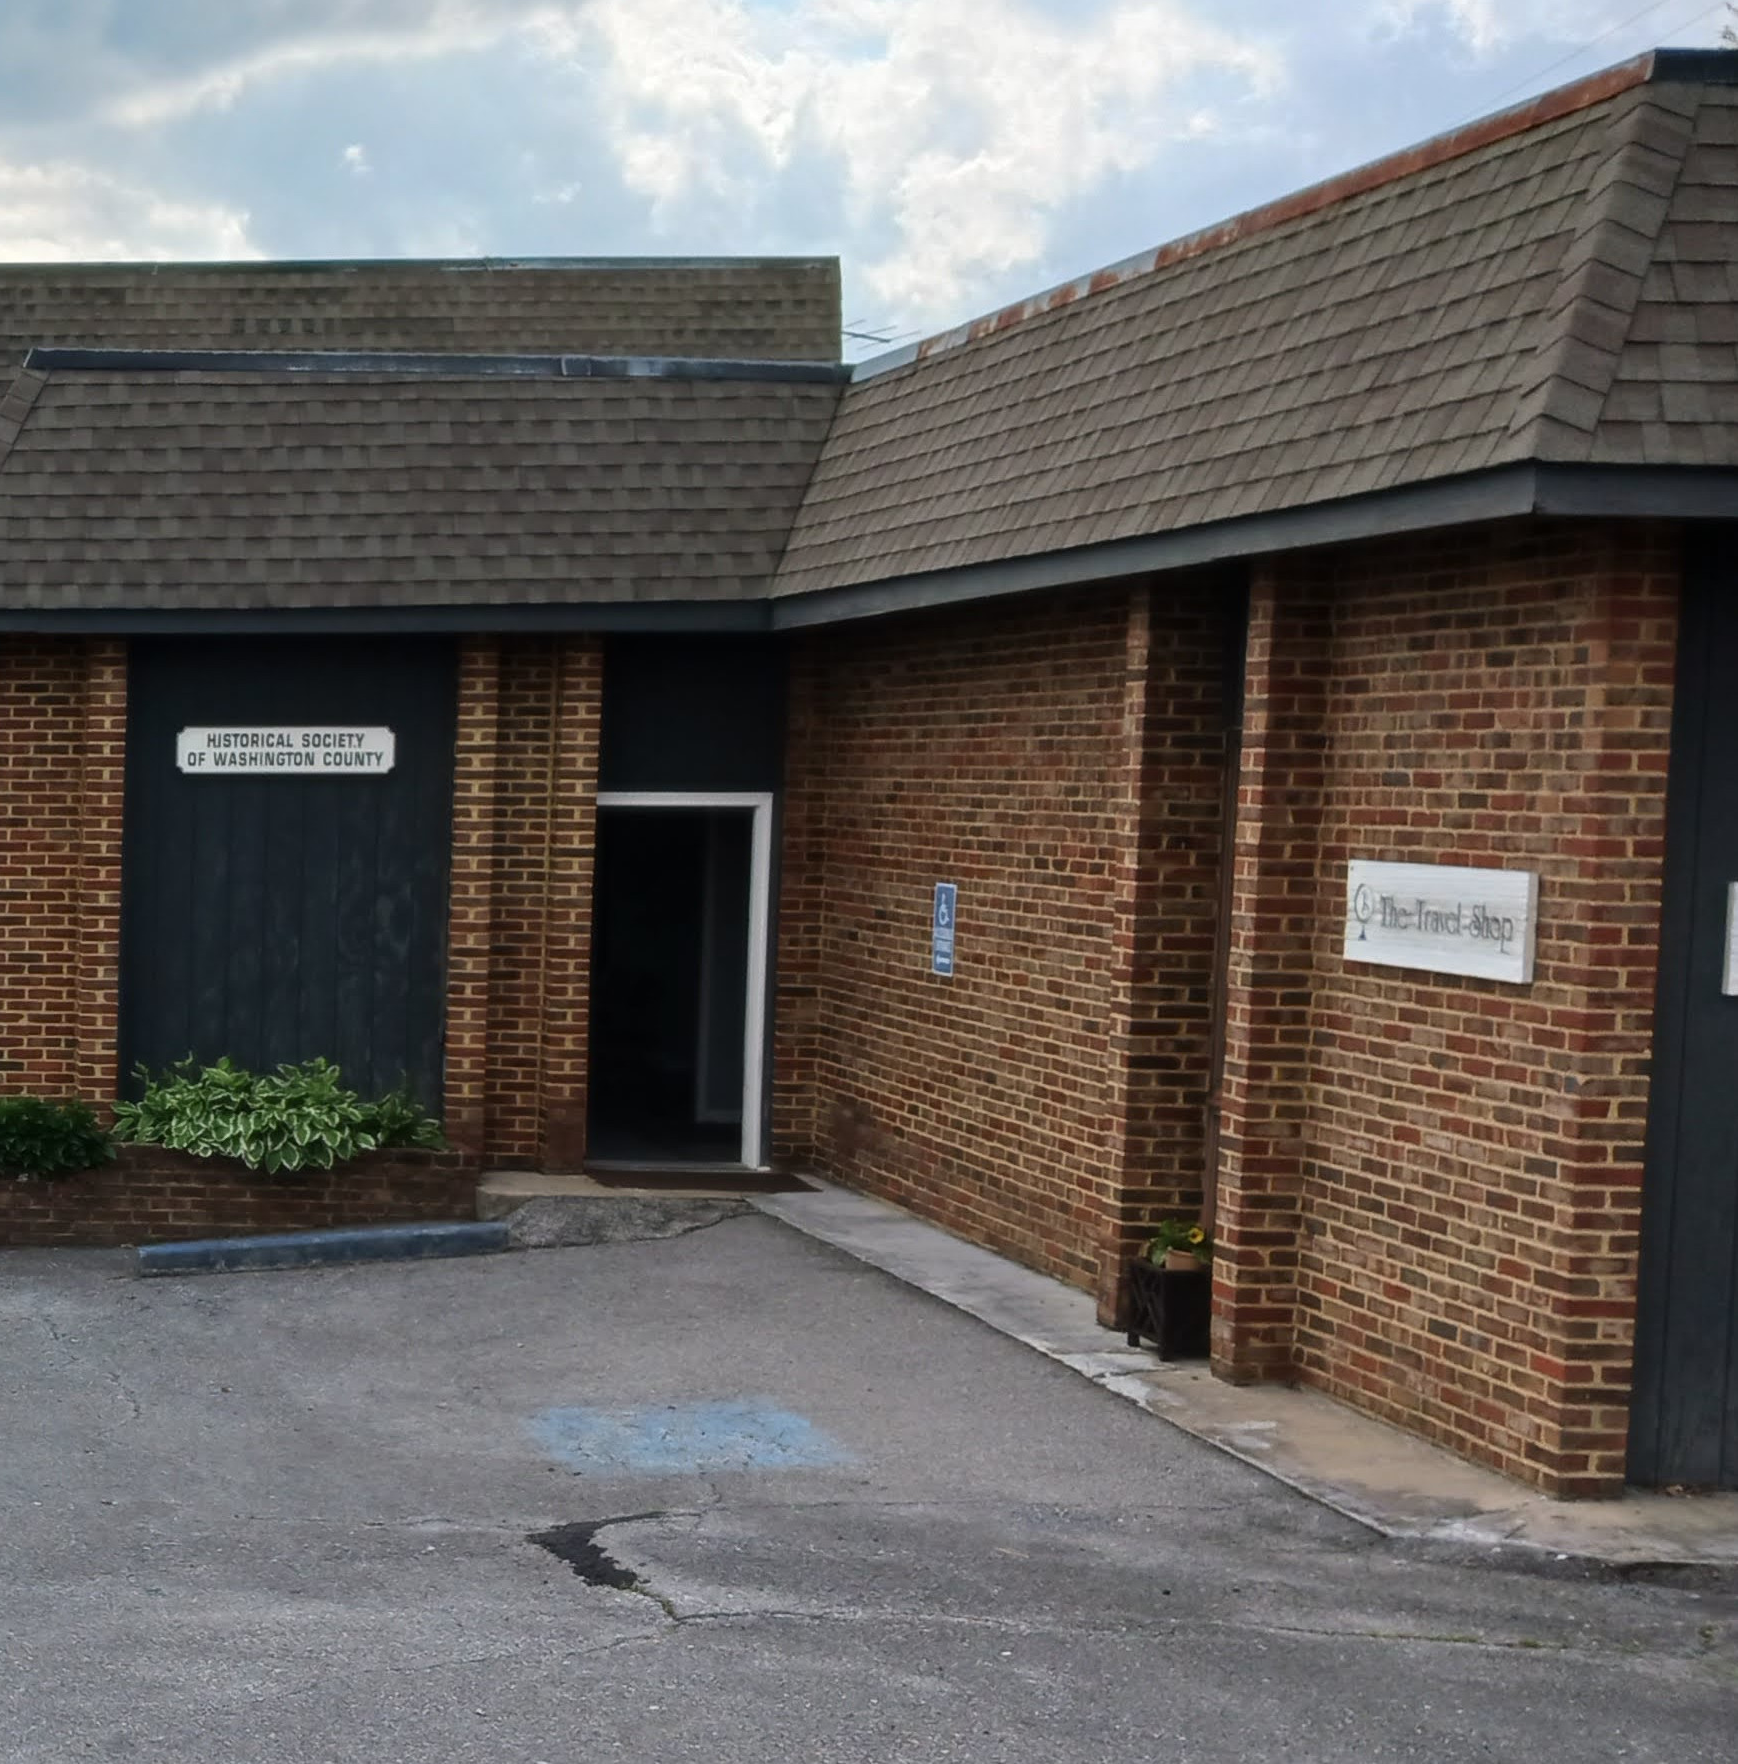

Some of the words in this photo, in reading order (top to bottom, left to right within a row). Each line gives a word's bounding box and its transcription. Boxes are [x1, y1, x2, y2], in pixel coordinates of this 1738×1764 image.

[206, 733, 293, 748] HISTORICAL
[301, 733, 365, 748] SOCIETY
[187, 752, 206, 767] OF
[213, 752, 315, 767] WASHINGTON
[323, 752, 383, 767] COUNTY
[1415, 899, 1461, 936] Travel
[1468, 904, 1514, 955] Shop
